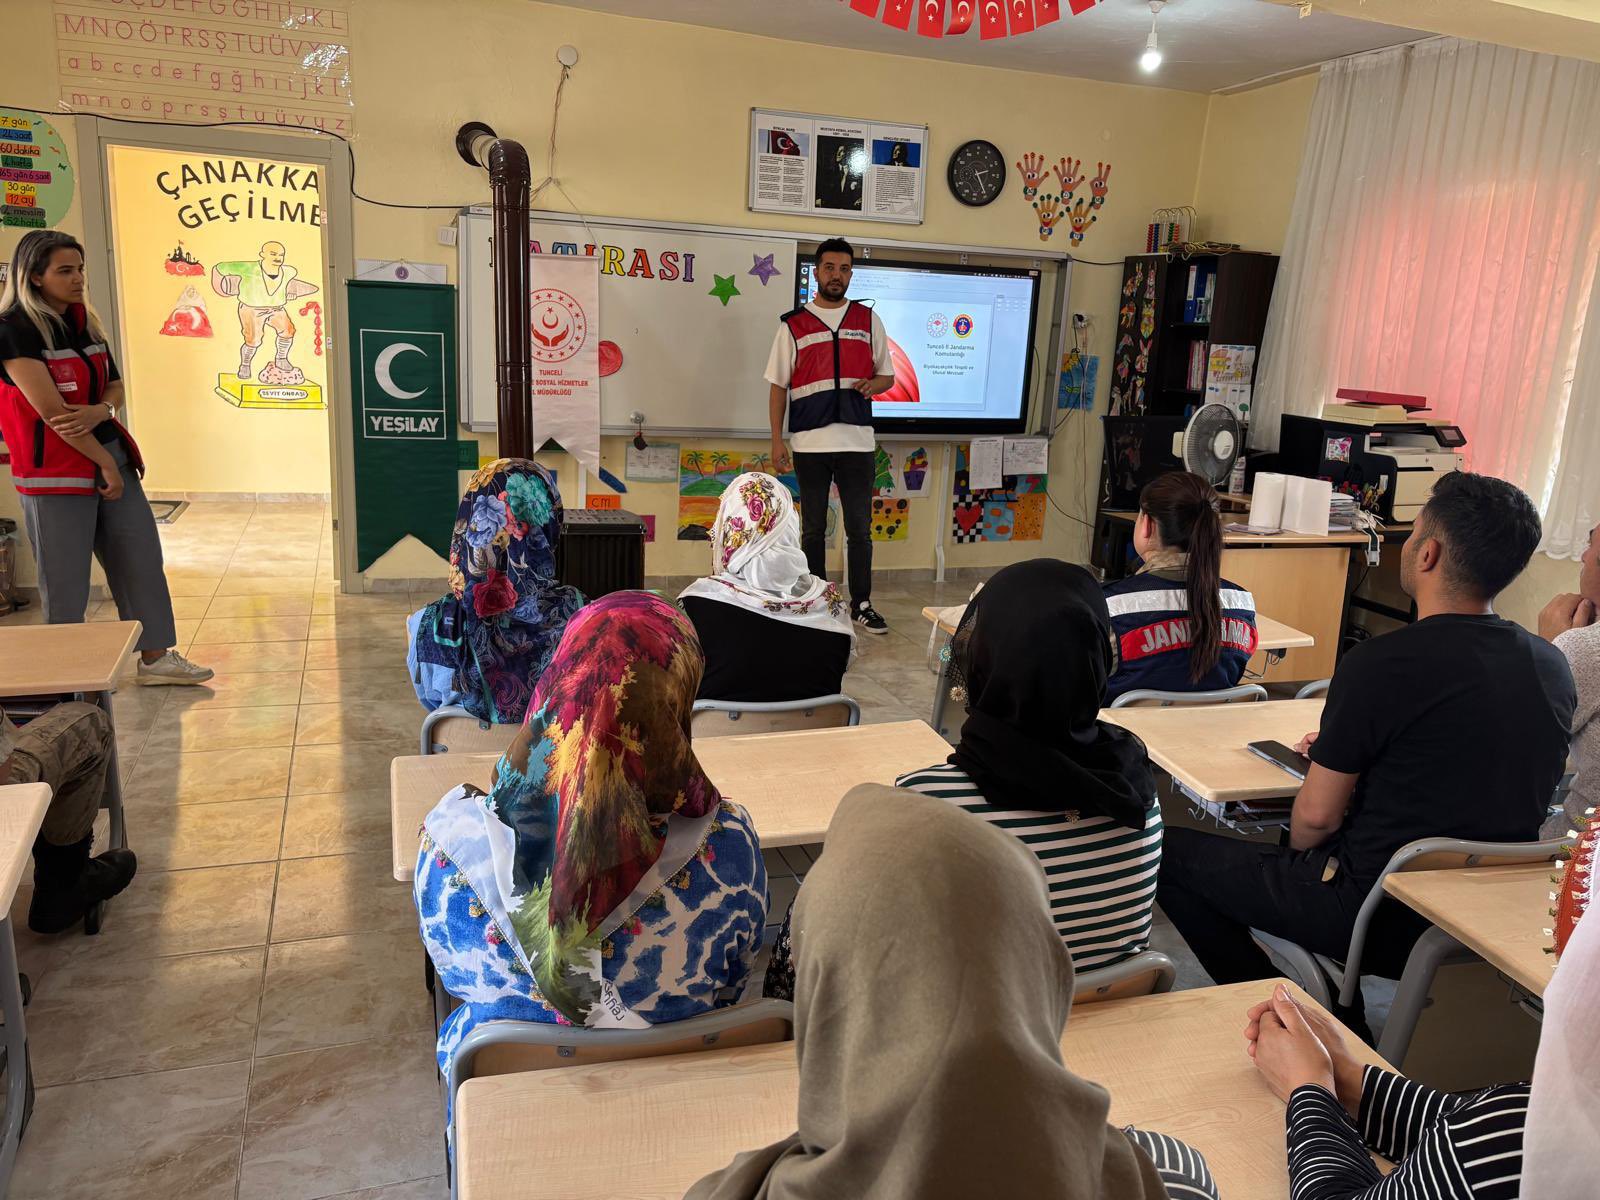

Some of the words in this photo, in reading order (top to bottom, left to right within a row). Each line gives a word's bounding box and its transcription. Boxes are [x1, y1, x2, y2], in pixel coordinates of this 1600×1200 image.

[1, 117, 8, 126] 7
[11, 118, 28, 128] gün
[0, 143, 12, 153] 60
[14, 144, 40, 155] dakika
[7, 182, 19, 191] 30
[20, 184, 35, 195] gün
[9, 194, 19, 205] 12
[21, 197, 34, 207] ay
[557, 379, 589, 387] HİZMETLER
[537, 388, 572, 396] MÜDÜRLÜĞÜ
[370, 415, 440, 434] YEŞİLAY
[1141, 620, 1250, 653] JANRMA
